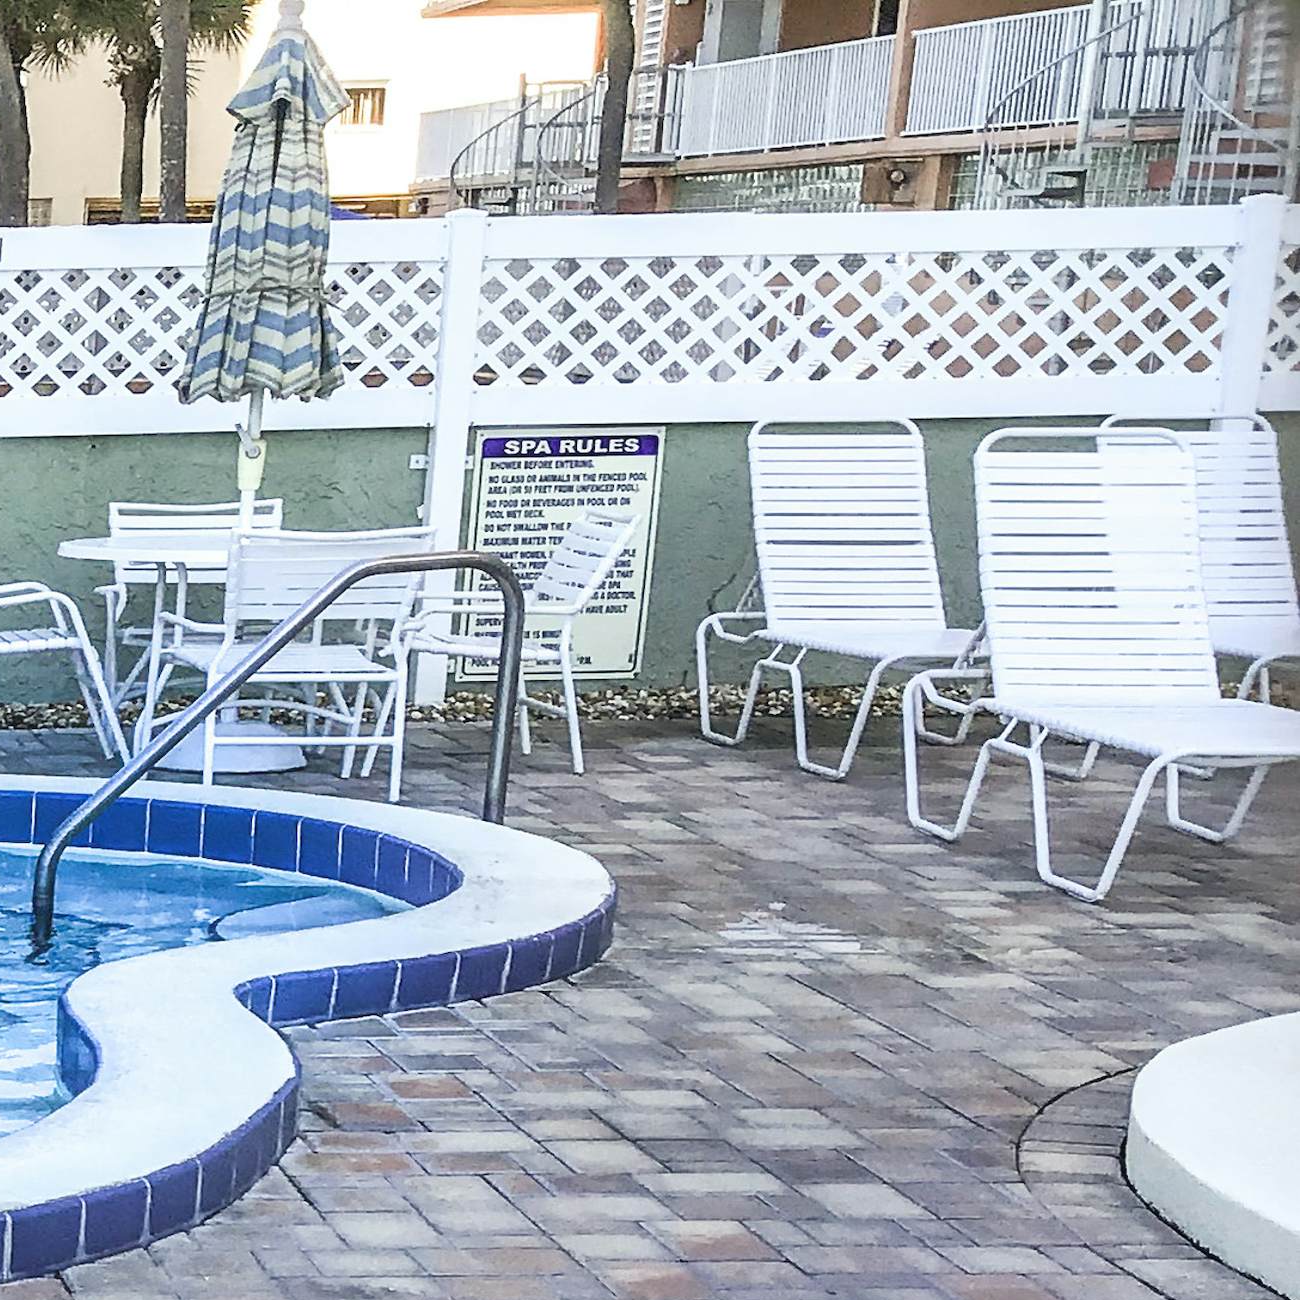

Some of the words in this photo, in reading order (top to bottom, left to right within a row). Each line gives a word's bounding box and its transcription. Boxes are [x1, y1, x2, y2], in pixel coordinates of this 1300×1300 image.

[504, 440, 551, 454] SPA
[559, 438, 640, 453] RULES
[524, 460, 552, 469] BEFORE
[488, 475, 499, 483] NO
[539, 474, 570, 482] ANIMALS
[573, 474, 580, 482] IN
[598, 473, 626, 481] FENCED
[629, 472, 647, 480] POOL
[488, 486, 507, 494] AREA
[486, 500, 497, 508] NO
[521, 499, 530, 507] OR
[587, 498, 605, 506] POOL
[484, 524, 494, 532] DO
[497, 524, 511, 532] NOT
[513, 523, 548, 531] SWALLOW
[551, 522, 564, 531] THE
[521, 536, 546, 545] WATER
